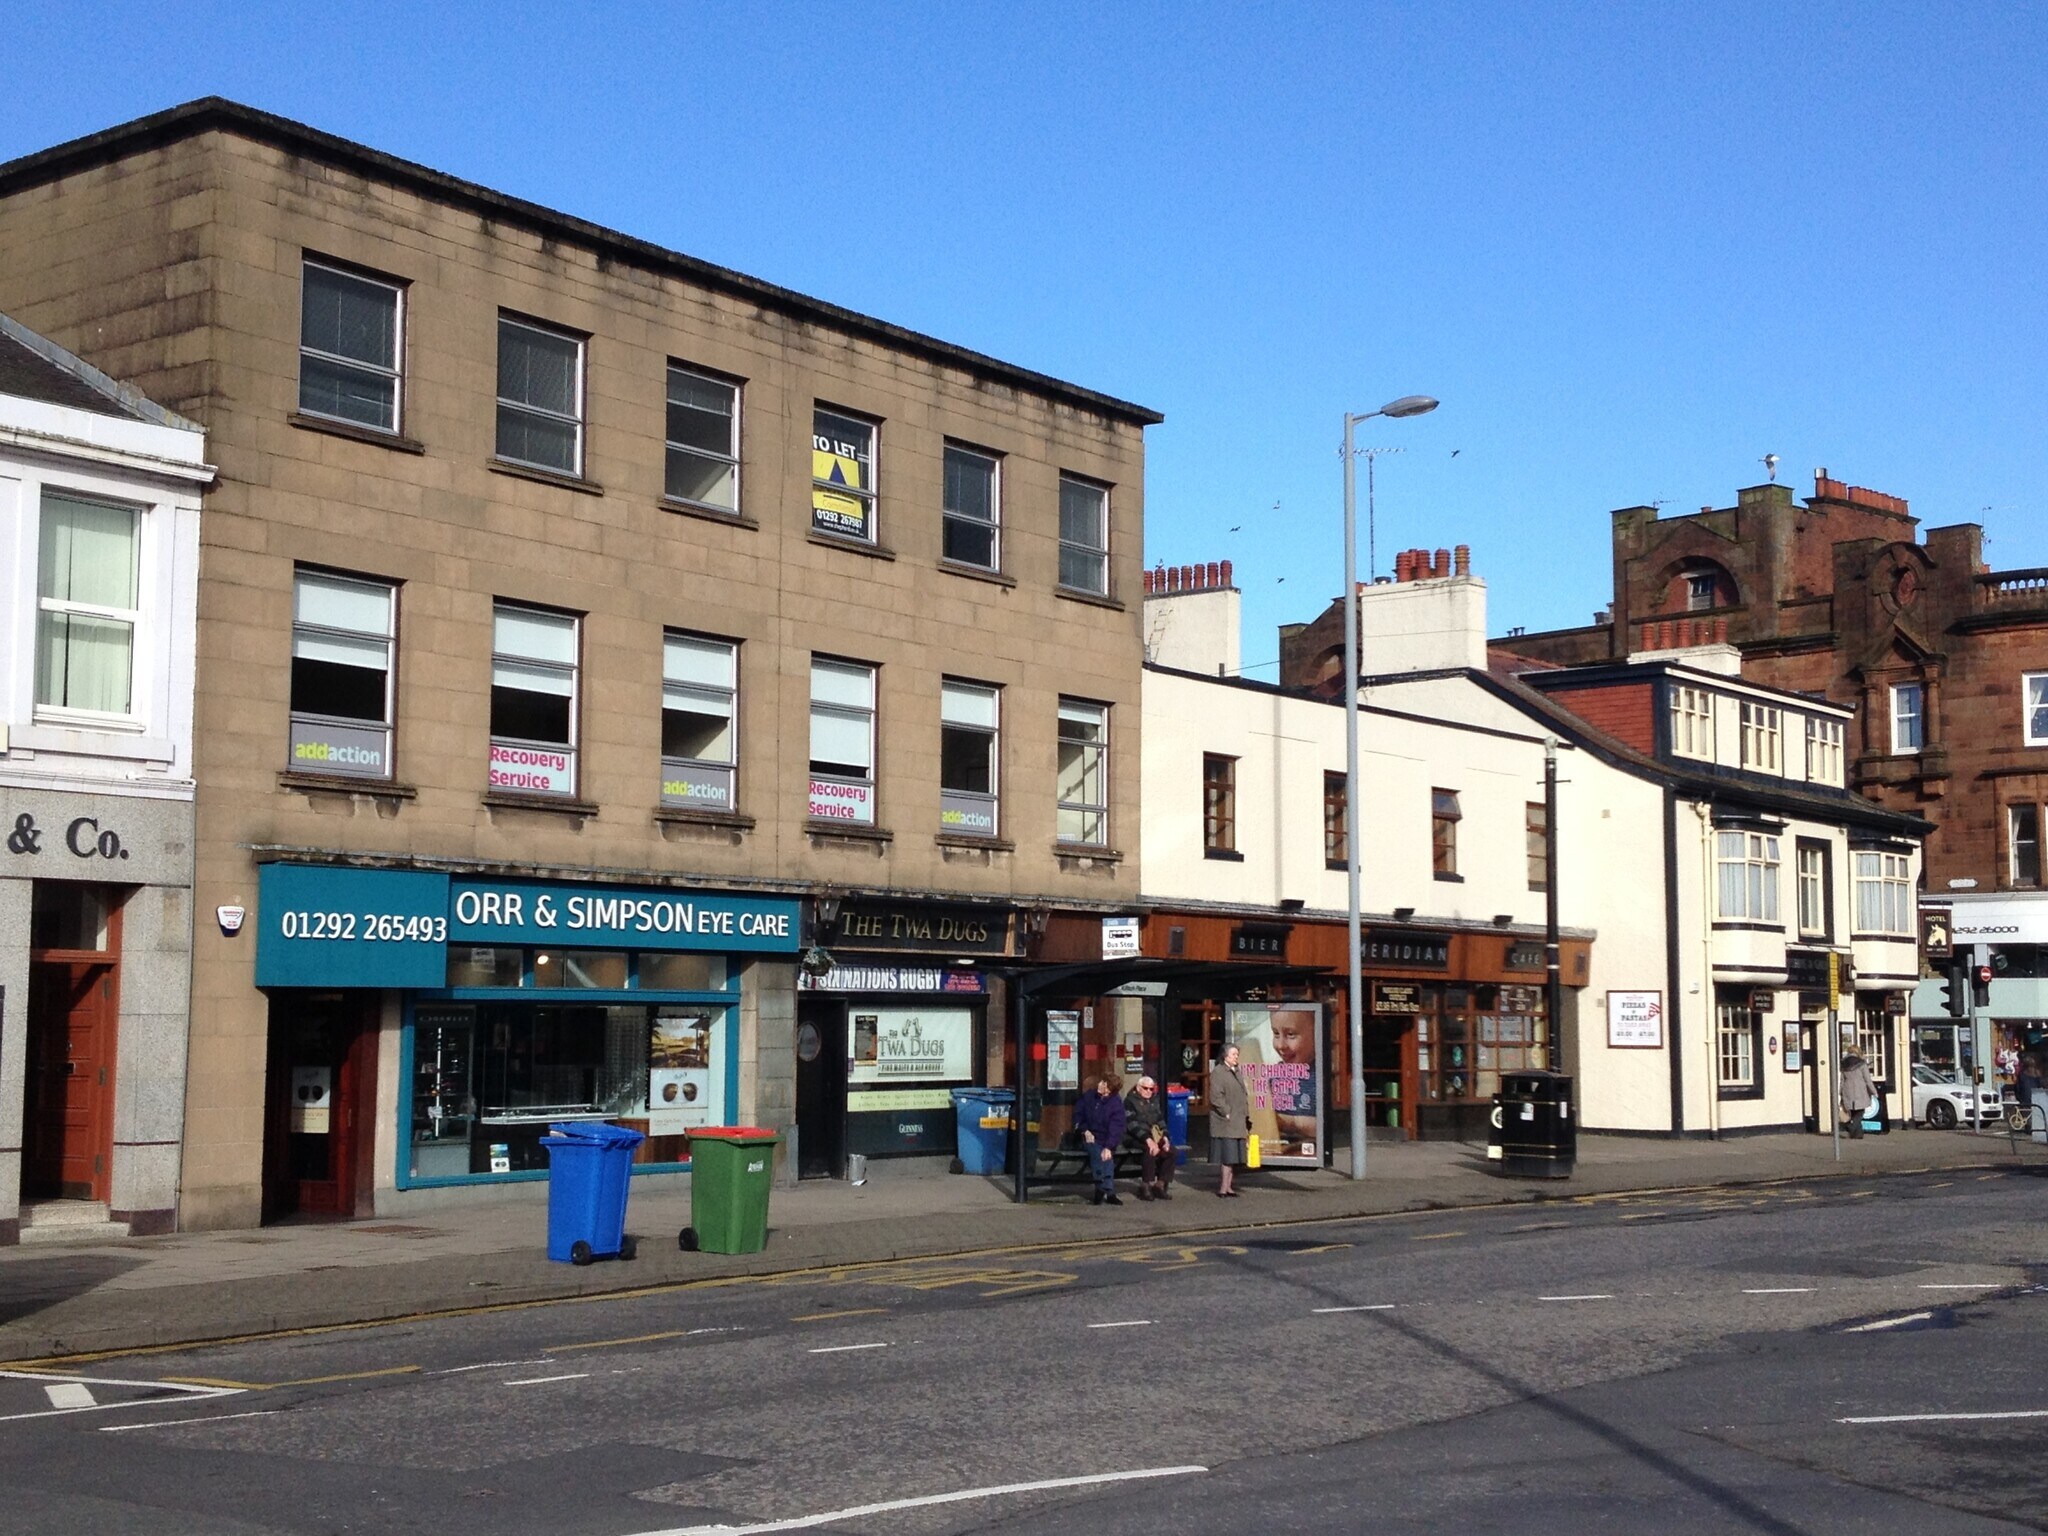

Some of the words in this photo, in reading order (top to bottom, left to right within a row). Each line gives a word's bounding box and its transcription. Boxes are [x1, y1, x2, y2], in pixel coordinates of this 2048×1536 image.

[813, 435, 830, 452] TO
[833, 440, 856, 460] LET
[295, 742, 380, 766] addaction
[490, 747, 565, 772] Recovery
[489, 769, 550, 789] Service
[663, 780, 726, 801] addaction
[809, 781, 867, 803] Recovery
[809, 801, 855, 818] Service
[942, 810, 991, 827] addaction
[7, 812, 42, 855] &
[66, 816, 129, 860] Co.
[456, 891, 524, 926] ORR
[534, 894, 557, 927] &
[567, 897, 693, 933] SIMPSON
[698, 911, 734, 934] EYE
[739, 913, 789, 937] CARE
[282, 911, 356, 939] 01292
[363, 914, 447, 942] 265493
[842, 911, 882, 937] THE
[891, 914, 932, 940] TWA
[936, 917, 989, 942] DUGS
[1239, 937, 1278, 951] BIER
[844, 967, 897, 990] NATIONS
[900, 968, 942, 991] RUGBY
[878, 1036, 907, 1057] TWA
[911, 1036, 944, 1057] DUGS
[1261, 1063, 1310, 1080] CHANGING
[1252, 1078, 1267, 1094] THE
[1271, 1079, 1300, 1095] GAME
[1255, 1094, 1265, 1110] IN
[899, 1123, 923, 1134] GUINNESS
